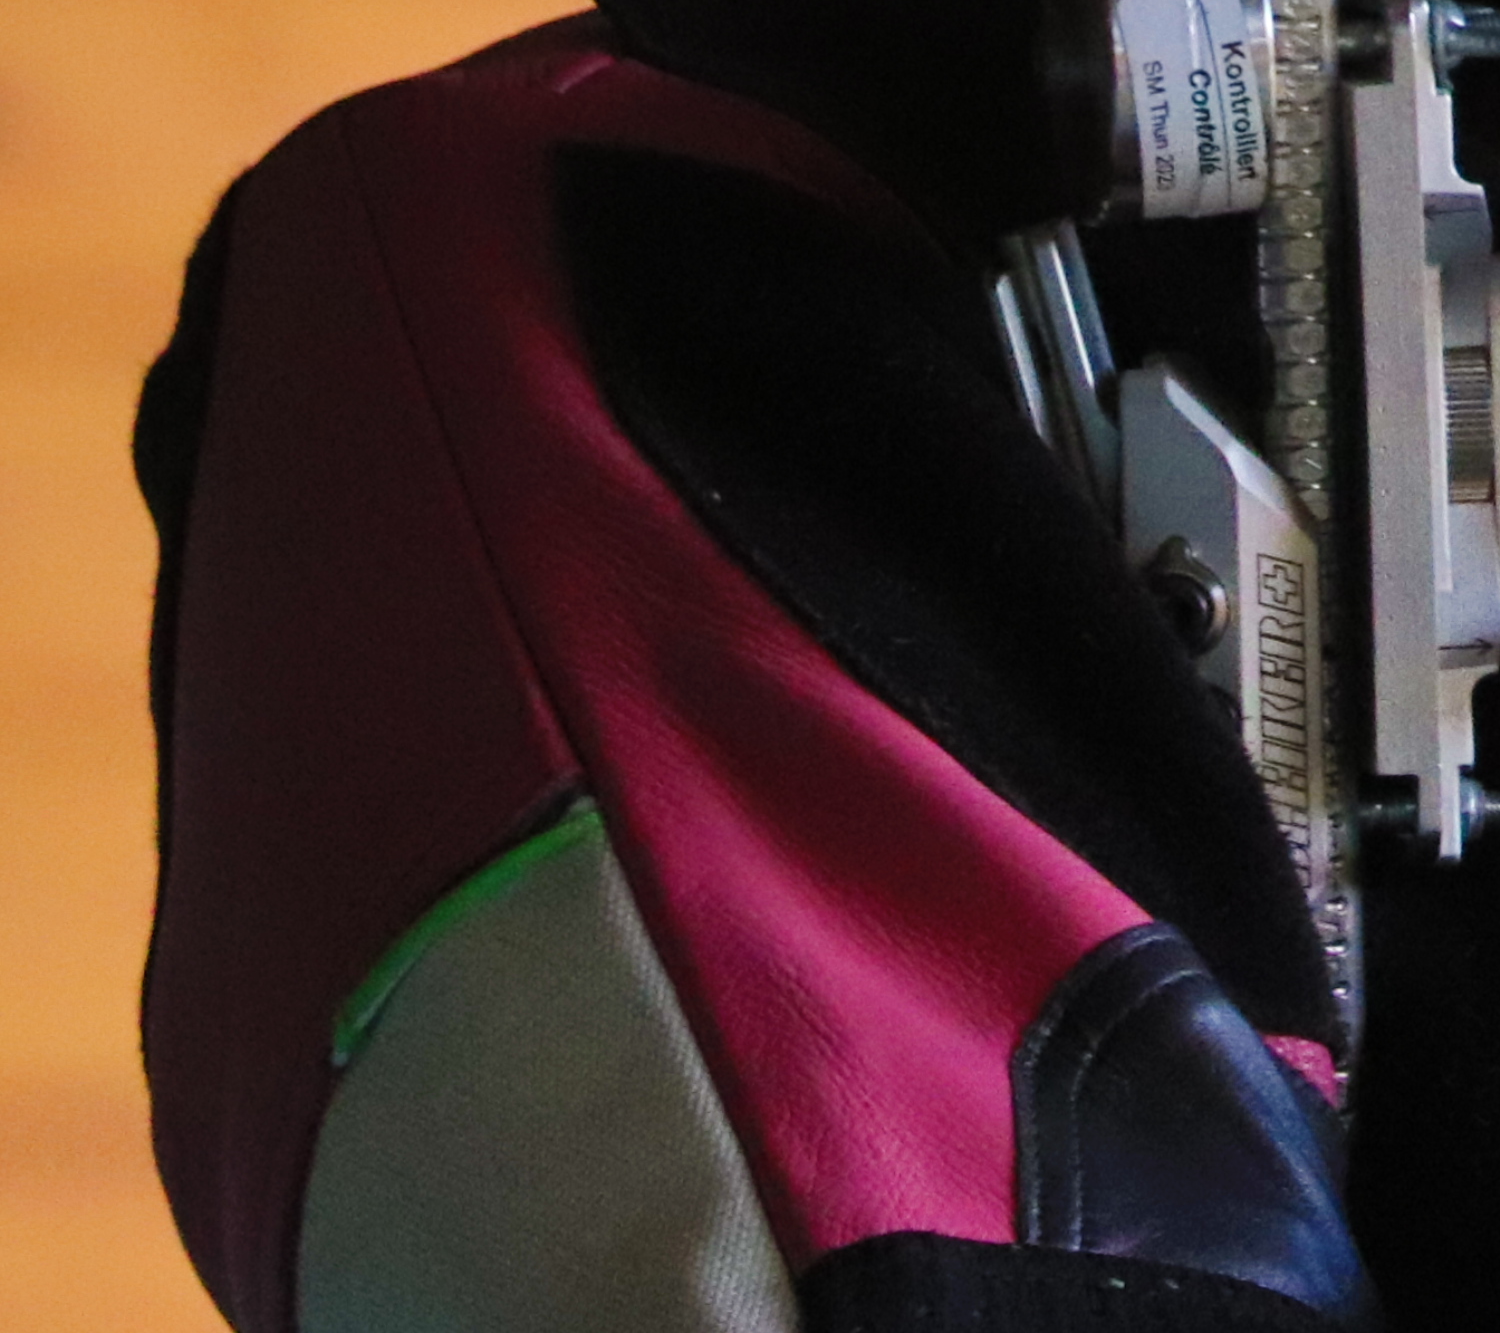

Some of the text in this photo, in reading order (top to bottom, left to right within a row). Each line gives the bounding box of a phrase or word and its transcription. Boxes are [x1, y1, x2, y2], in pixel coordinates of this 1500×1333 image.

[1142, 60, 1167, 96] SM
[1221, 40, 1260, 182] Kontrolliert
[1150, 100, 1170, 150] Thun
[1188, 68, 1223, 176] Contrôlé
